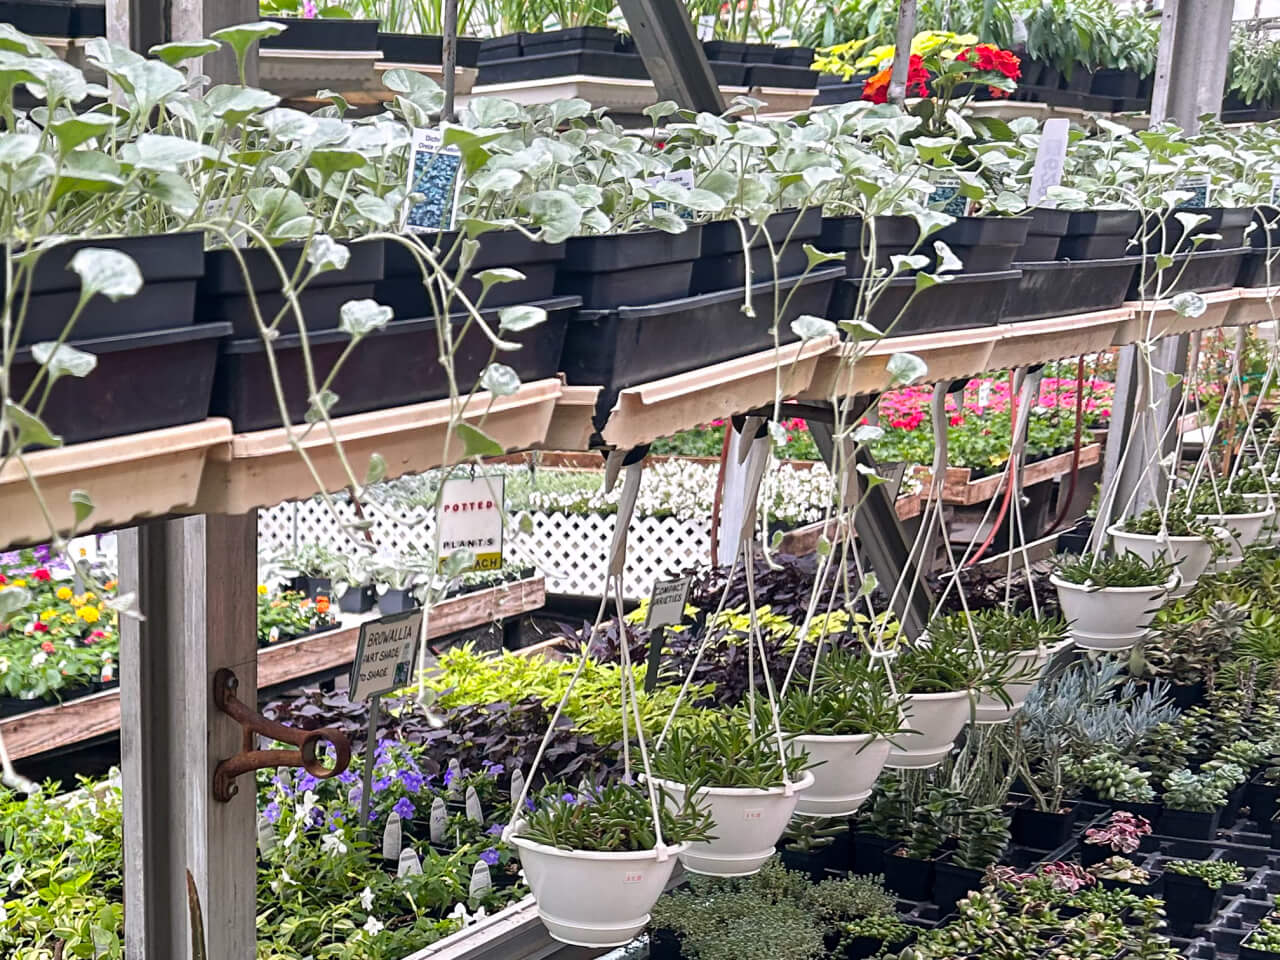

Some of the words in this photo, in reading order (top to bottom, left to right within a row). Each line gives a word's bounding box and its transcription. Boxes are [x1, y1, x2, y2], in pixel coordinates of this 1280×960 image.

[443, 499, 493, 513] POTTED
[442, 537, 494, 549] PLANTS
[473, 557, 497, 569] ACH
[367, 625, 412, 648] BROWALLIA
[379, 646, 400, 661] SHADE
[366, 667, 388, 681] SHADE
